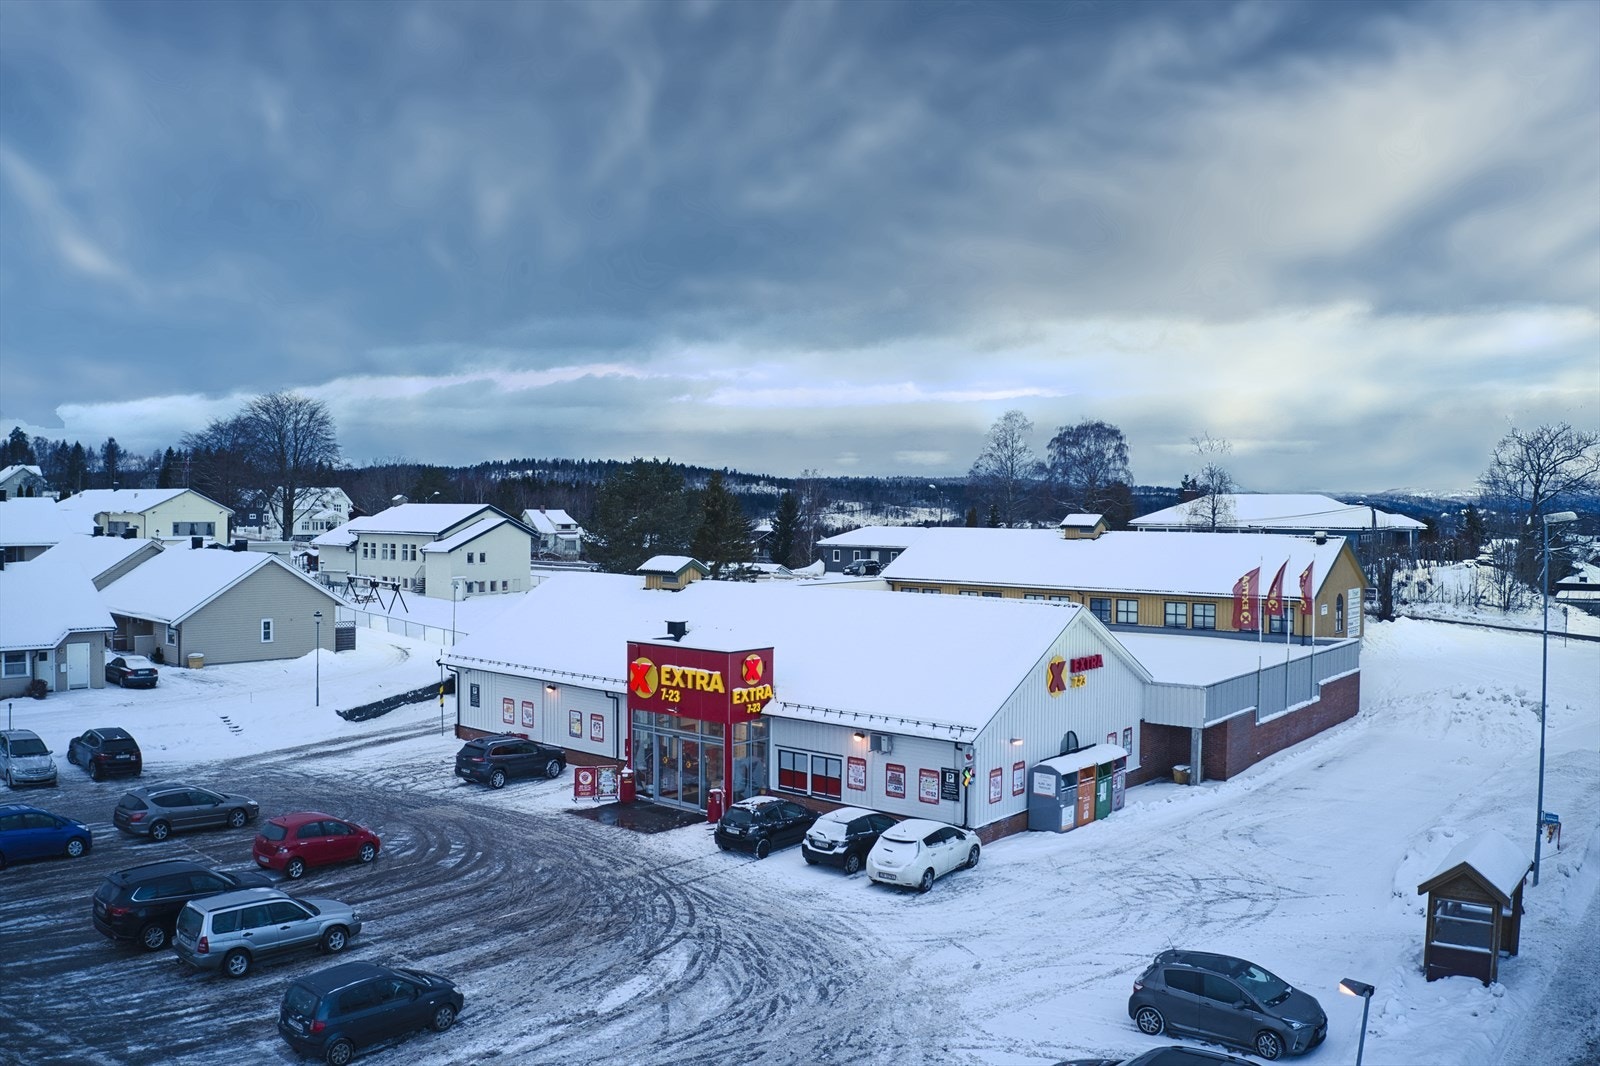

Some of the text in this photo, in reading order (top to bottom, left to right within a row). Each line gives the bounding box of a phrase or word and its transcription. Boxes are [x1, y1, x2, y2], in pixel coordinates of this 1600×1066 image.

[1070, 654, 1103, 673] EXTRA
[660, 665, 725, 693] EXTRA
[660, 688, 680, 702] 7-23
[732, 684, 773, 704] EXTRA
[746, 703, 761, 713] 7-23
